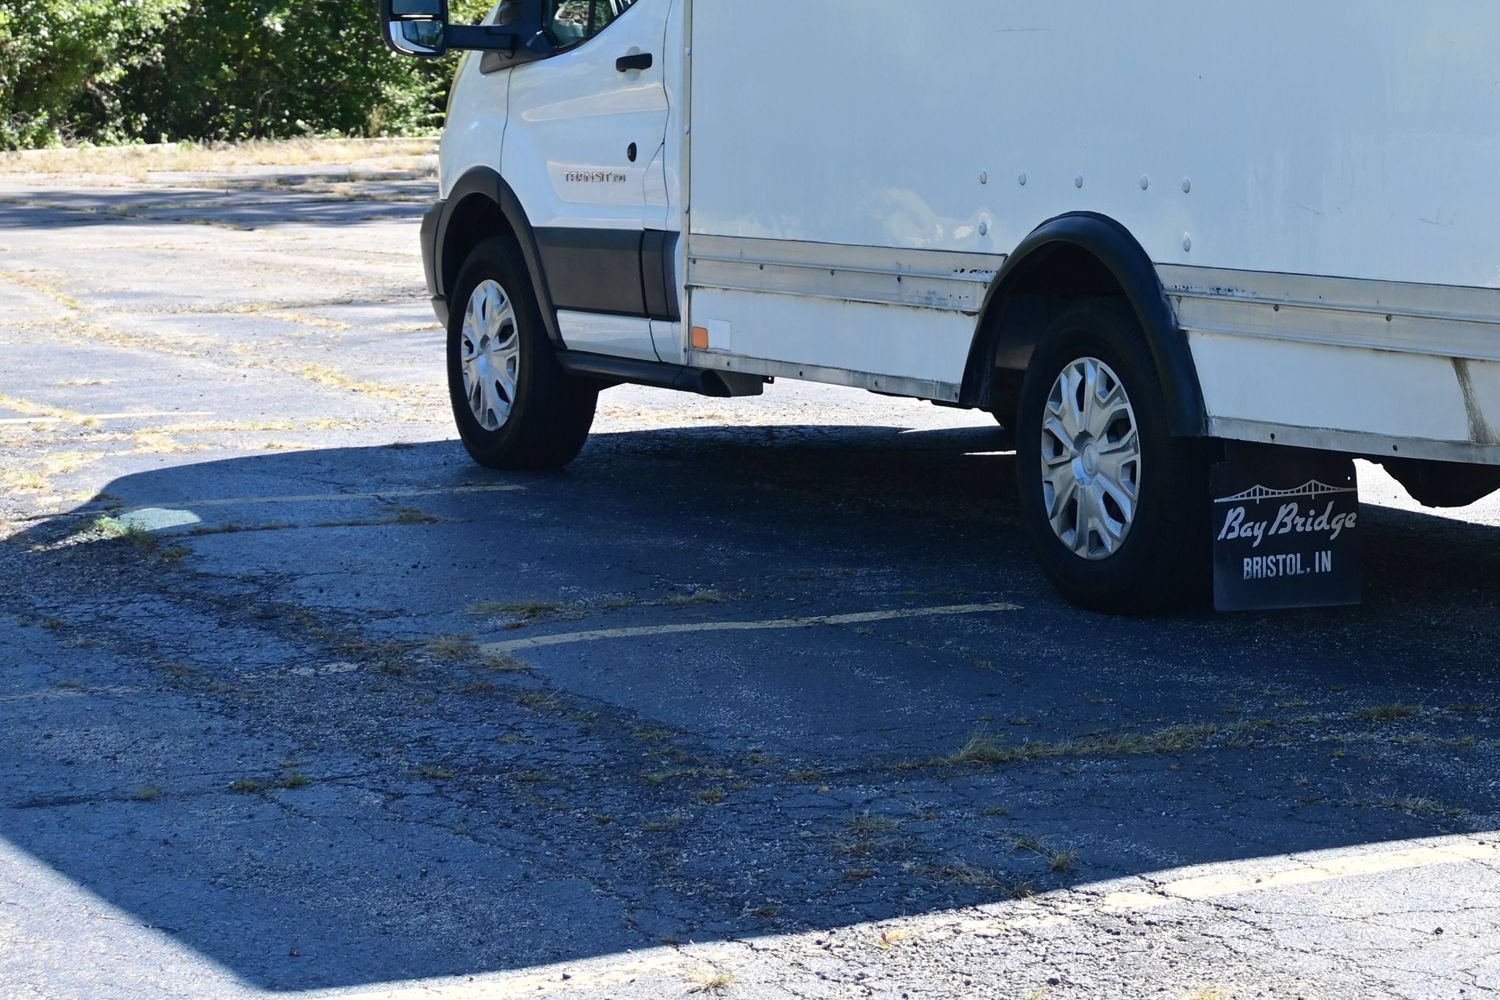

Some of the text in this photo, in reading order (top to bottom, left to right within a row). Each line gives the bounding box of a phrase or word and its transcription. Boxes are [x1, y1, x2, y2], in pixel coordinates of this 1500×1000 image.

[1217, 500, 1358, 548] Bay Bridge
[1243, 551, 1332, 580] BRISTOL, IN
